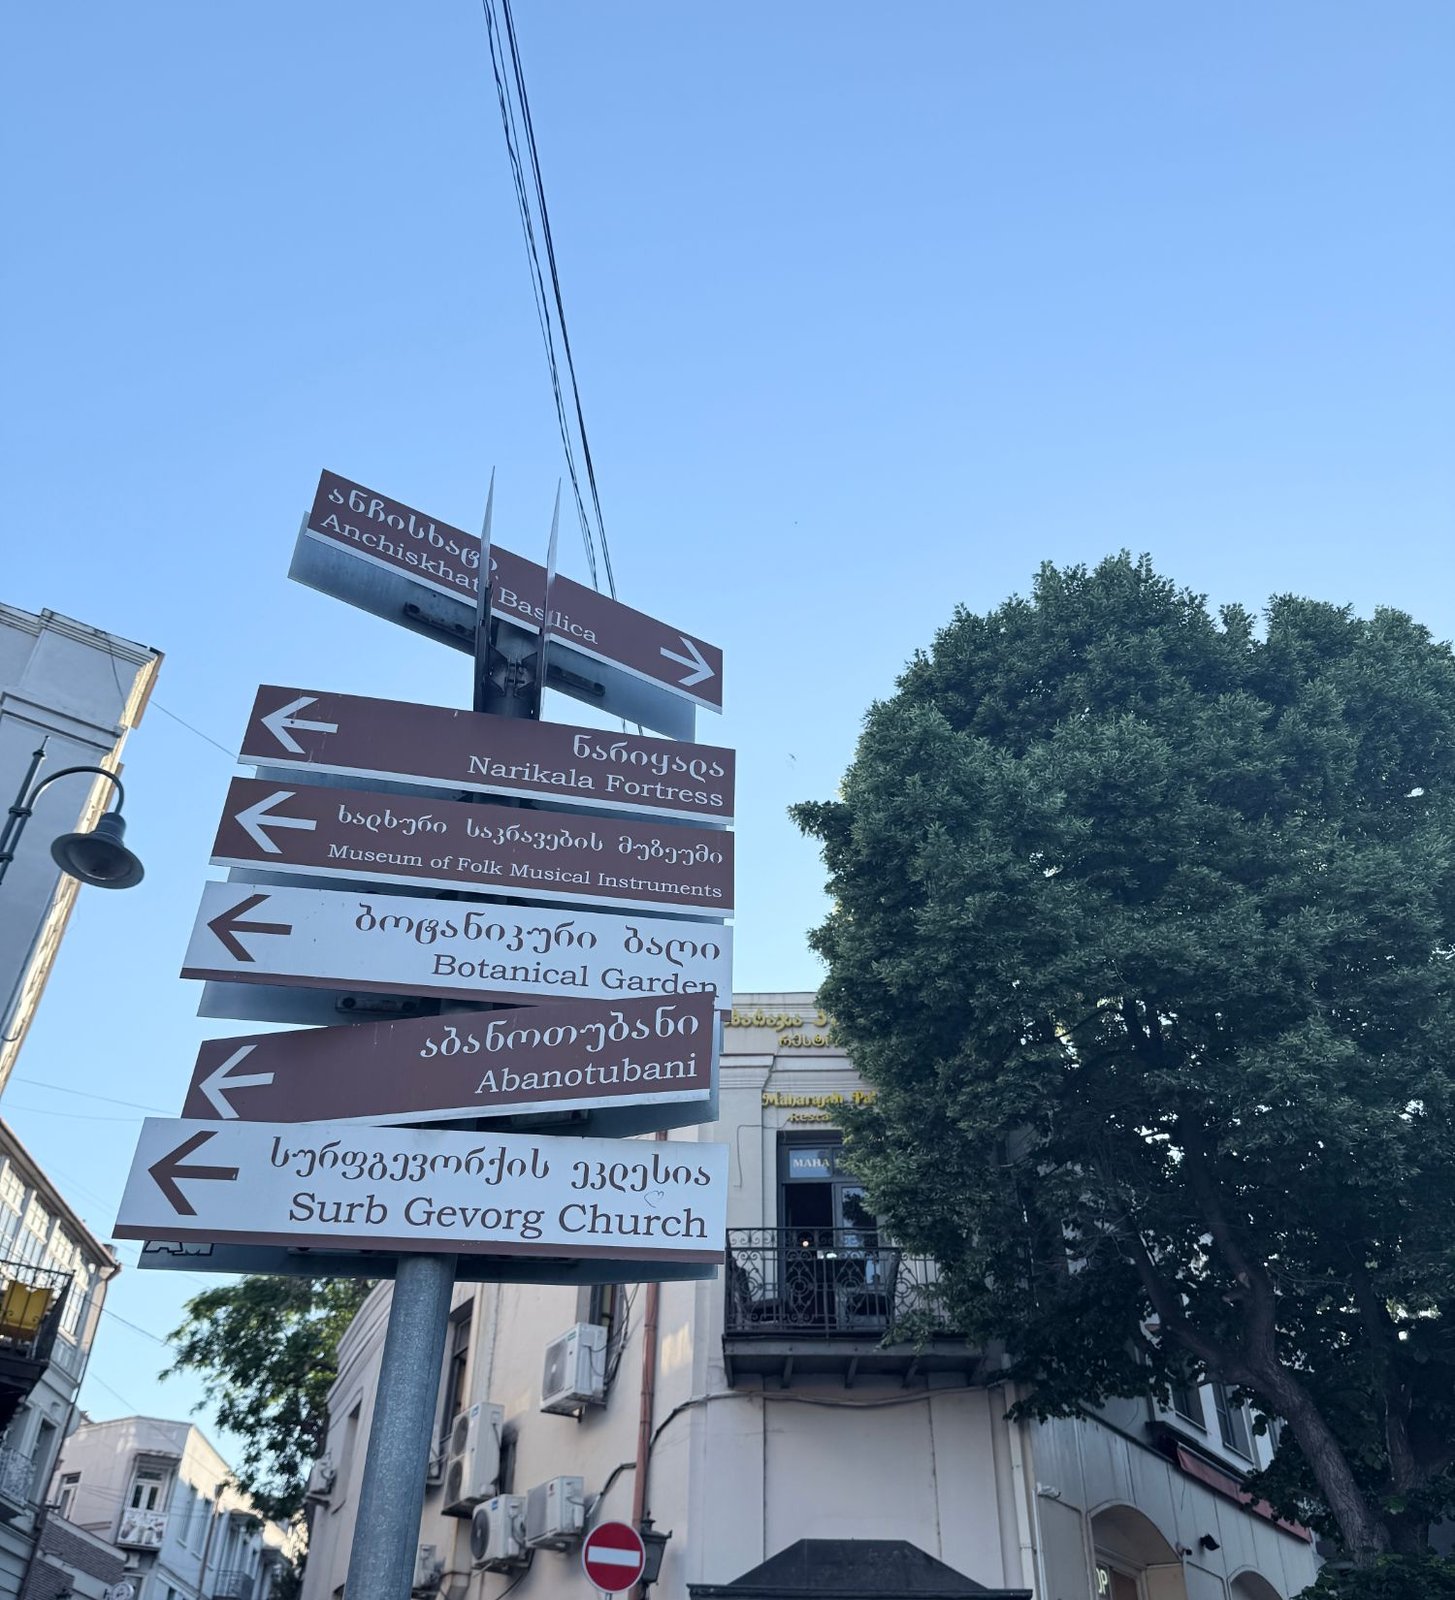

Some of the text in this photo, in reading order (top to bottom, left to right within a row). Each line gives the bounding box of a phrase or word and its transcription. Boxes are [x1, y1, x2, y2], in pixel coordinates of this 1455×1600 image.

[320, 514, 498, 593] Anchiskhat
[467, 755, 724, 807] Narikala Fortress
[573, 734, 725, 783] ნარიყალა
[338, 804, 723, 866] ხალხური საკრავების მუზეუმი
[328, 843, 723, 898] Museum of Folk Musical Instruments
[355, 902, 721, 968] ბოტანიკური ბაღი
[432, 953, 720, 998] Botanical Garden
[420, 1004, 699, 1058] აბანოთუბანი
[474, 1052, 698, 1095] Abanotubani
[571, 1154, 711, 1192] ეკლესია
[289, 1193, 708, 1239] Surb Gevorg Church
